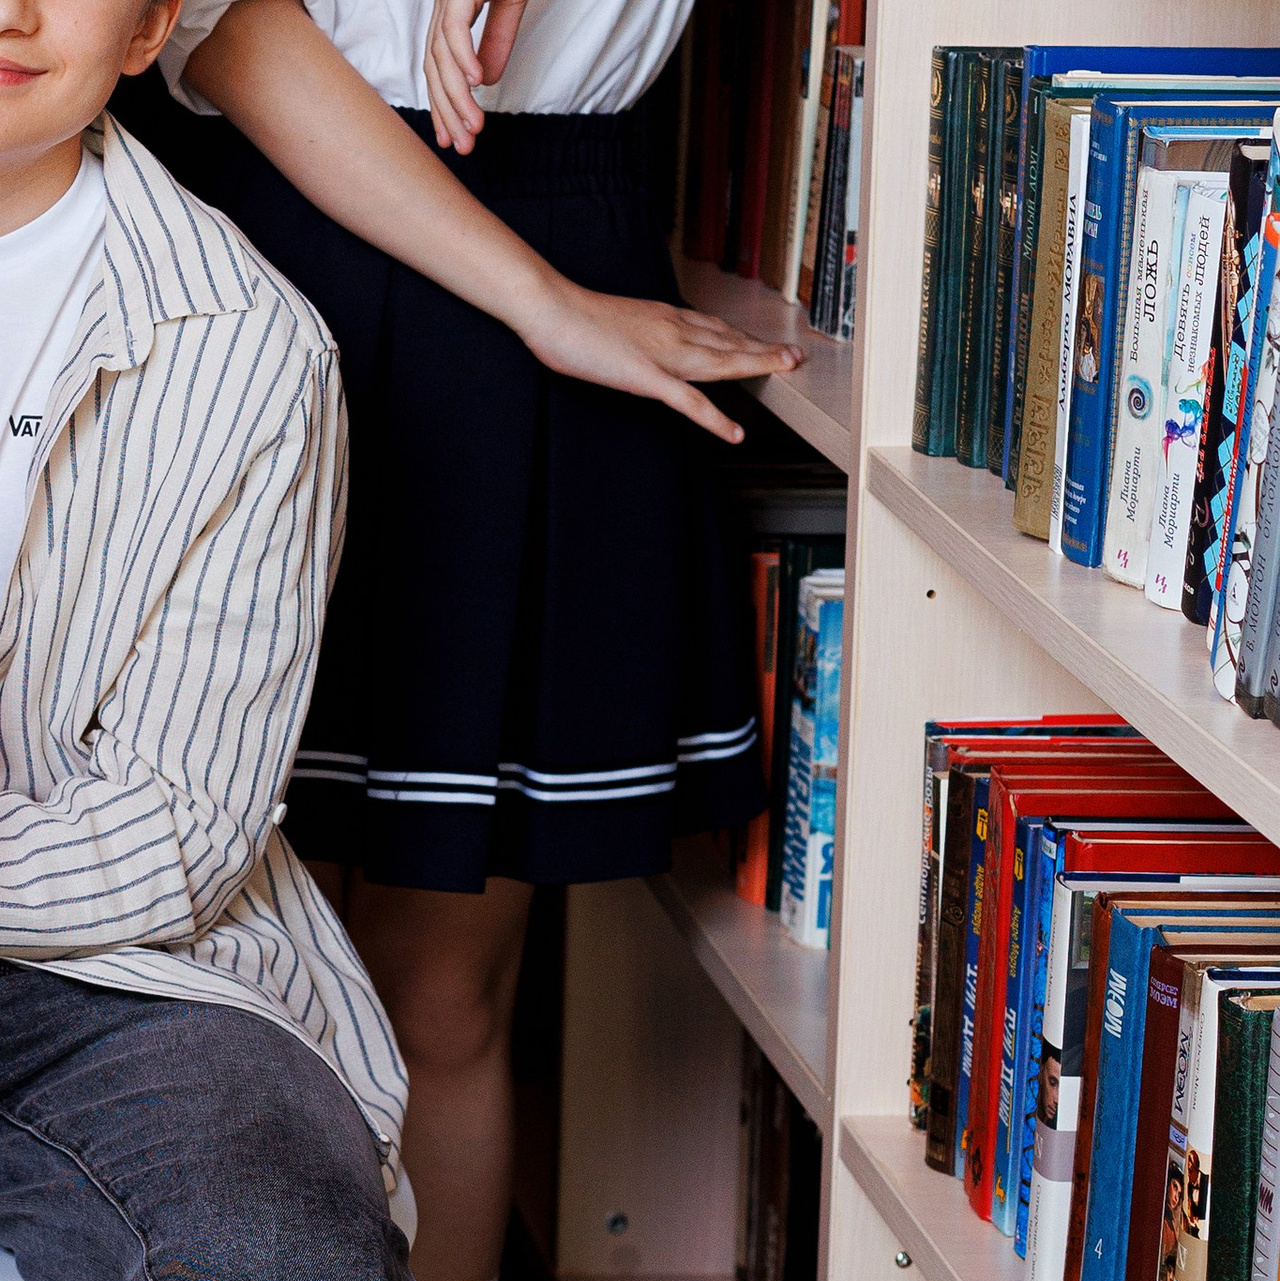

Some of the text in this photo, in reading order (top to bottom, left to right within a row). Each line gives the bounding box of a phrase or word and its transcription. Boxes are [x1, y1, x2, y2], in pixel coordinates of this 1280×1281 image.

[1058, 195, 1077, 412] Альберто МОРАВИА
[1129, 189, 1149, 363] Большая маленькая
[1173, 233, 1197, 362] Девять совсем
[1187, 291, 1203, 378] незнакомых
[8, 415, 43, 437] VA
[1120, 460, 1132, 504] Лиана
[1126, 446, 1142, 523] Мориарти
[1158, 485, 1170, 529] Лиана
[1163, 472, 1180, 549] Мориарти
[1245, 640, 1254, 652] В.
[1250, 556, 1266, 636] МОРТОН
[1264, 522, 1272, 539] ОТ
[919, 766, 934, 925] Сентябрьские розы
[1008, 904, 1022, 978] Андре Моруа
[1104, 967, 1128, 1039] МОЭМ
[1150, 986, 1178, 1008] МОЭМ
[1174, 1030, 1190, 1116] МОЭМ
[1095, 1238, 1103, 1259] 4
